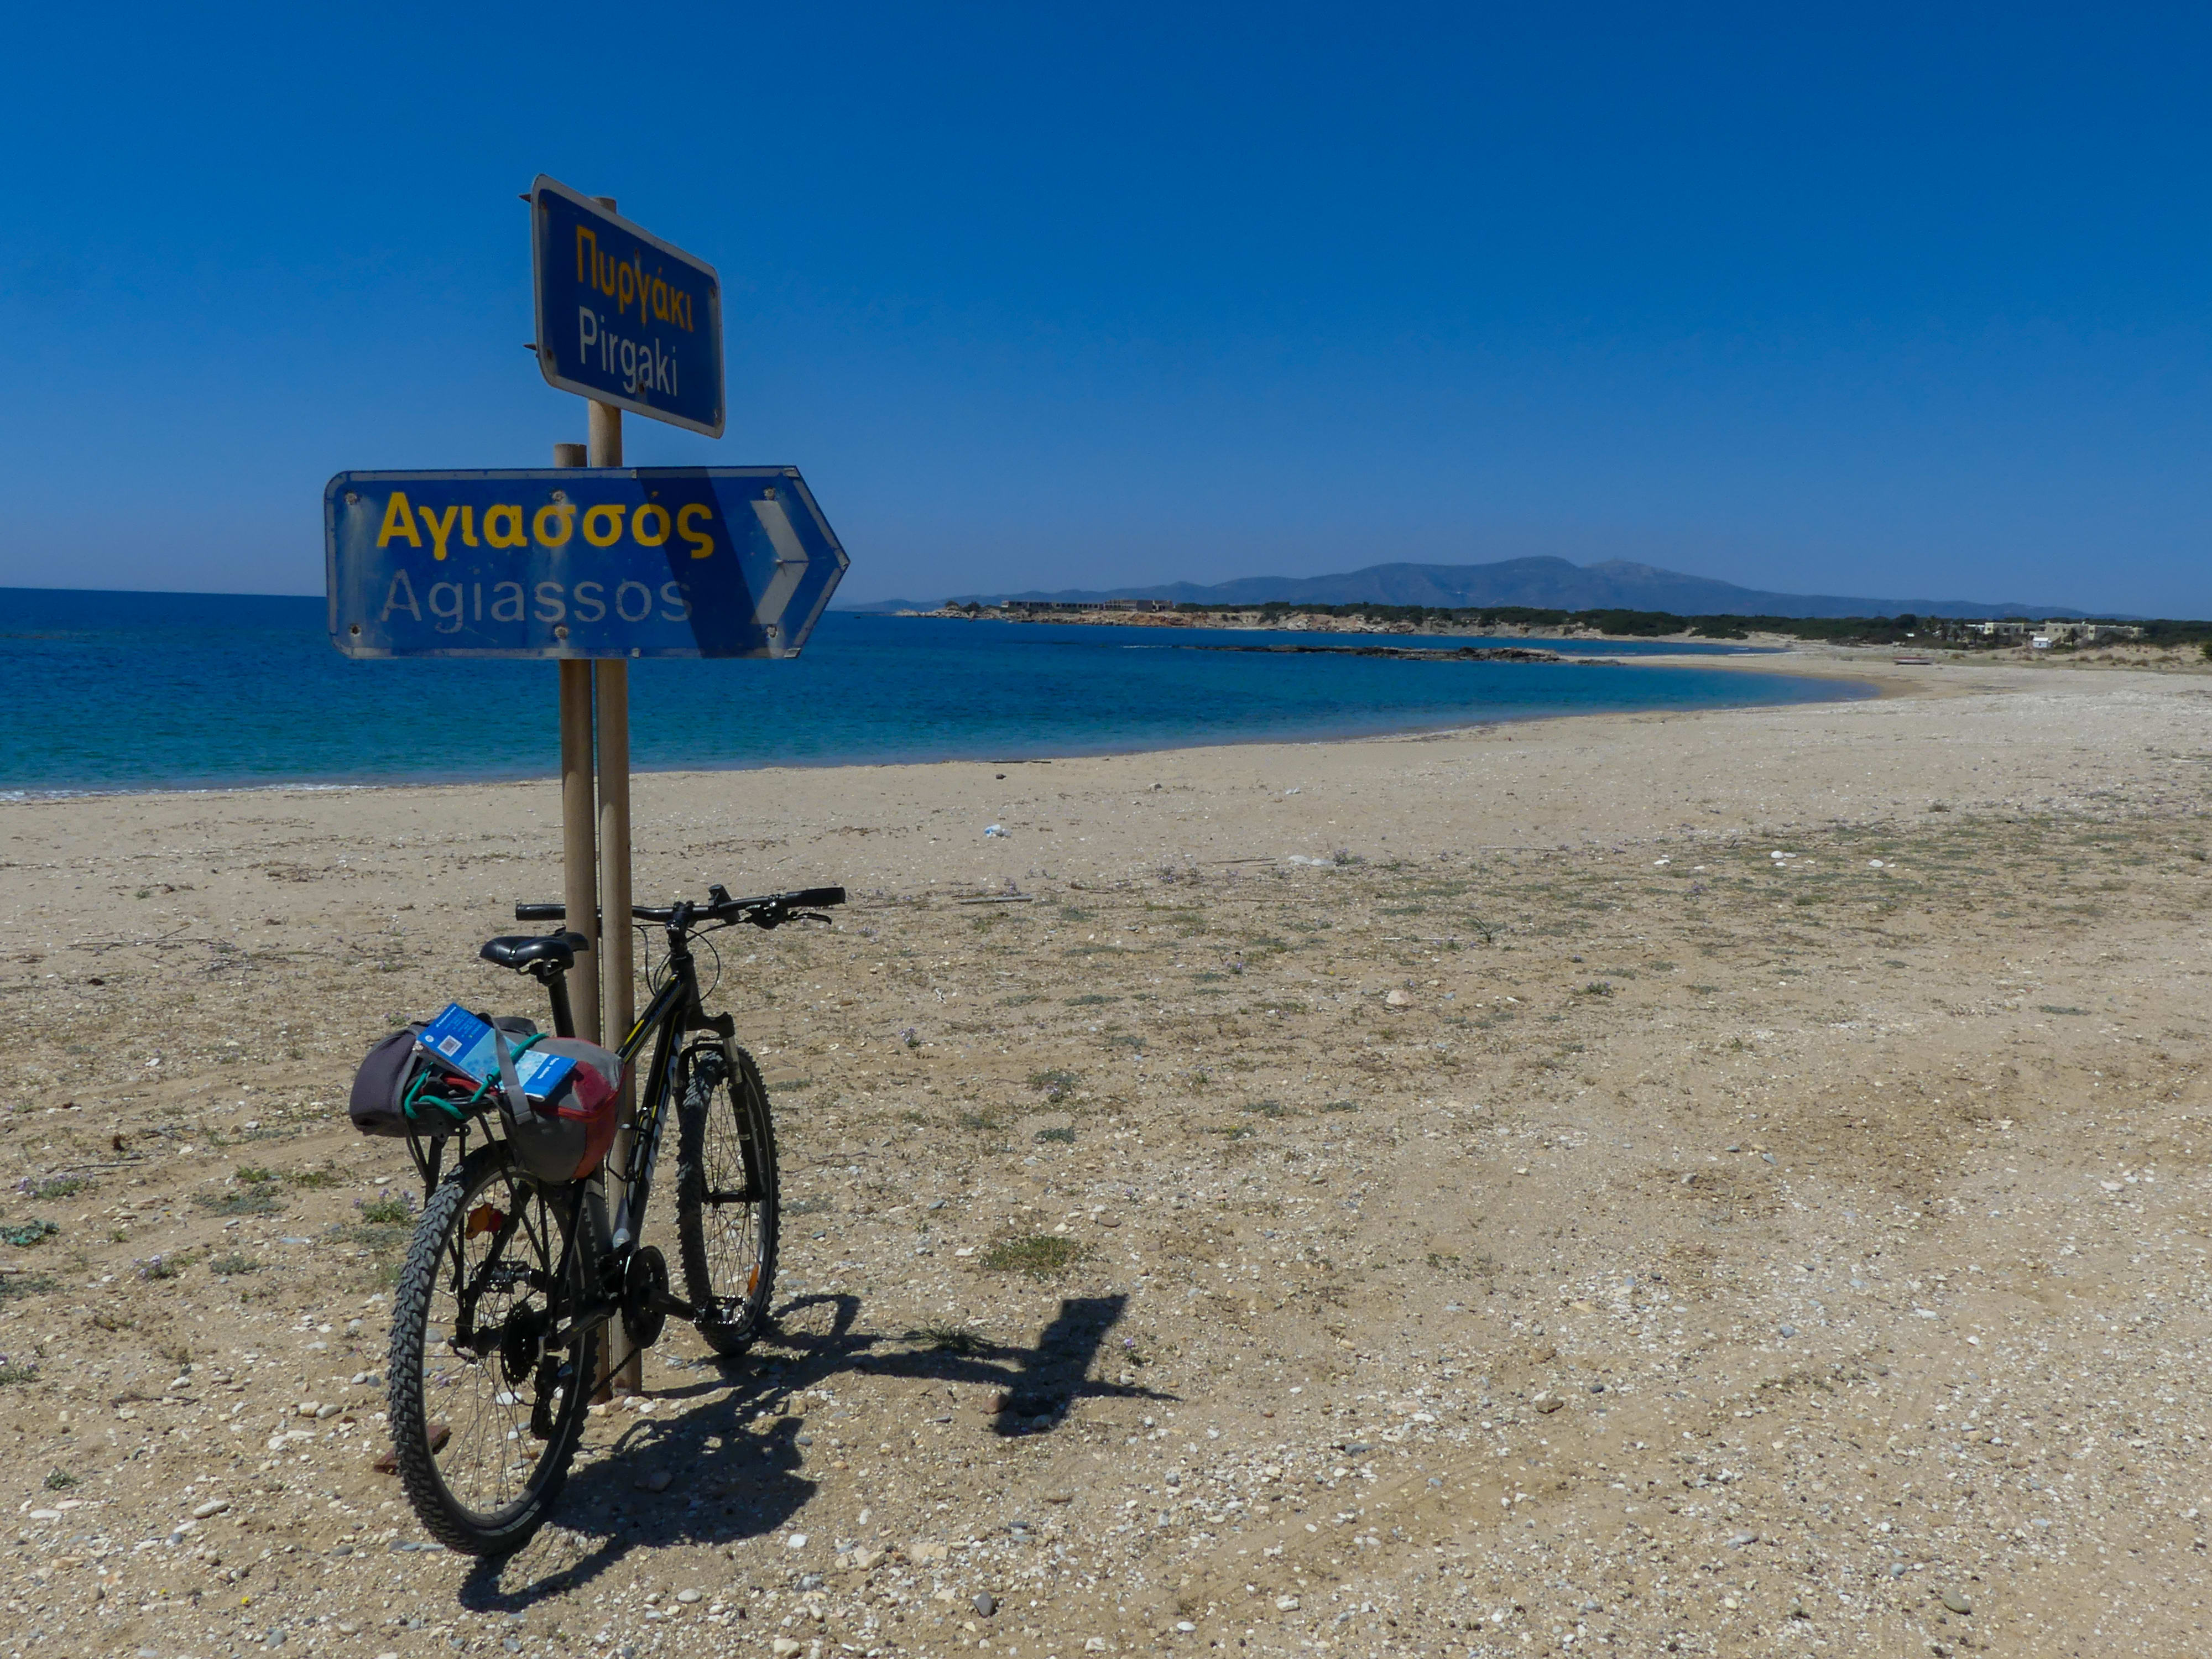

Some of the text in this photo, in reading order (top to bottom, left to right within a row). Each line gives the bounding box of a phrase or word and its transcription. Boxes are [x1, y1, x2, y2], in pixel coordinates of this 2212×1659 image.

[576, 225, 693, 332] Πυργάκι
[579, 305, 678, 397] Pirgaki
[377, 491, 714, 560] Αγιασσός
[380, 568, 692, 634] Agiassos
